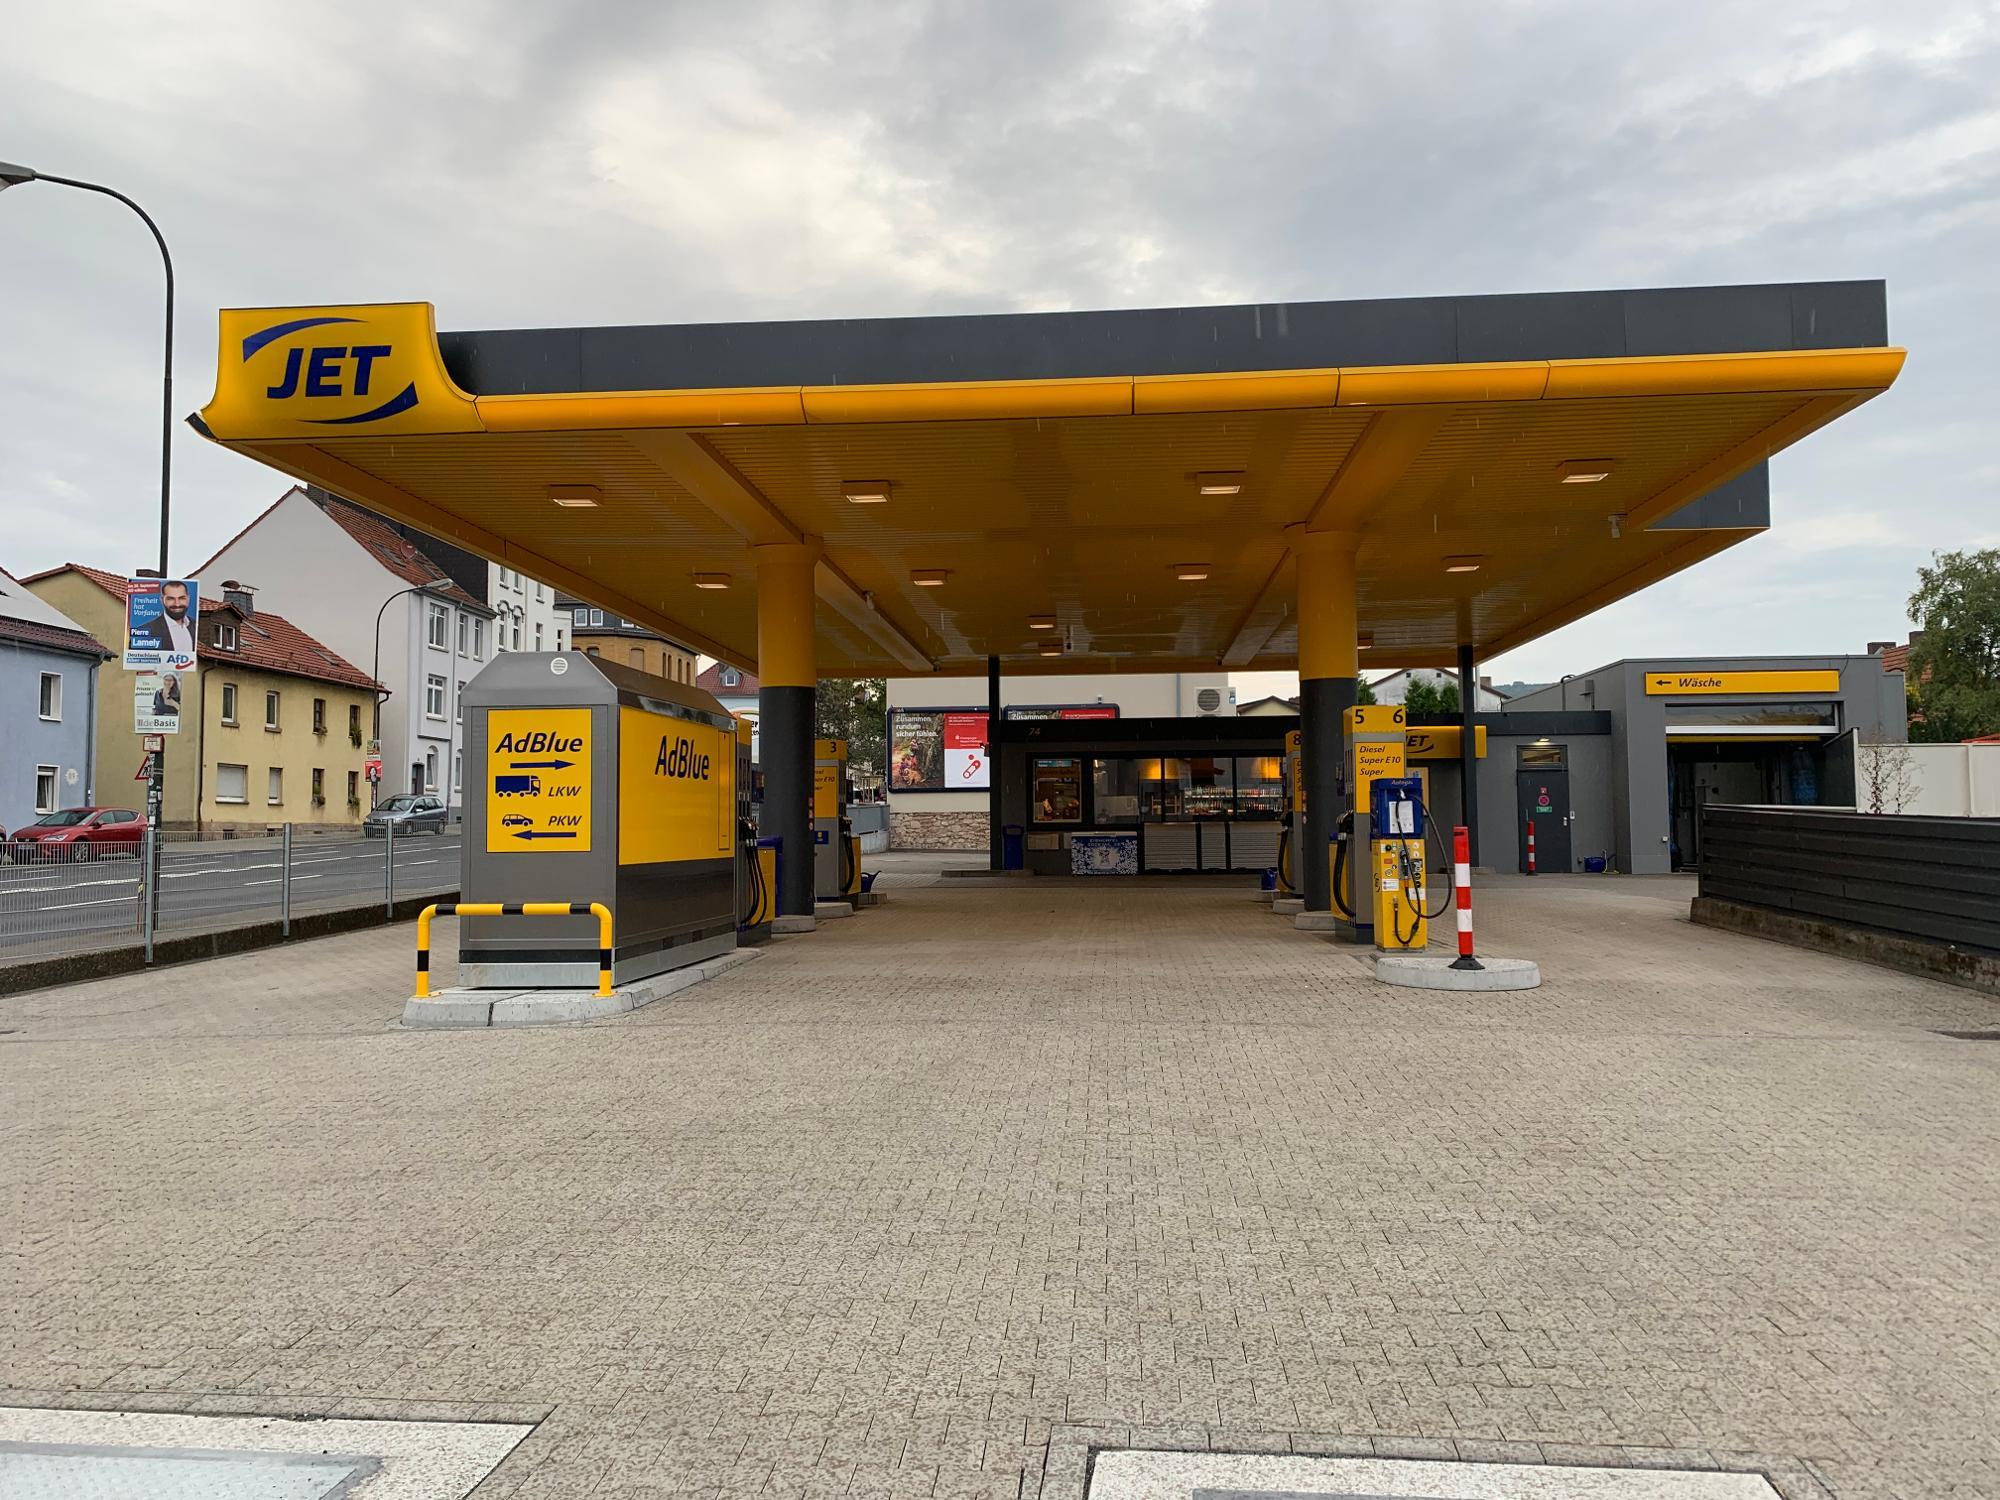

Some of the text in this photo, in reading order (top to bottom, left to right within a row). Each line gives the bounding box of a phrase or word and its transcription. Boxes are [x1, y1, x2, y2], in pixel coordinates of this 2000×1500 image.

[267, 345, 392, 399] JET
[131, 628, 149, 636] Pierre
[132, 638, 160, 648] Lamely
[166, 654, 190, 664] AfD
[1679, 678, 1722, 688] Wäsche
[1355, 708, 1404, 724] 5 6
[495, 731, 583, 753] AdBlue
[1406, 735, 1430, 747] ET
[830, 742, 837, 753] 3
[1359, 745, 1385, 753] Diesel
[655, 735, 709, 780] AdBlue
[1359, 756, 1401, 765] Super E10
[1359, 768, 1384, 777] Super
[548, 785, 582, 797] LKW
[548, 815, 583, 827] PKW
